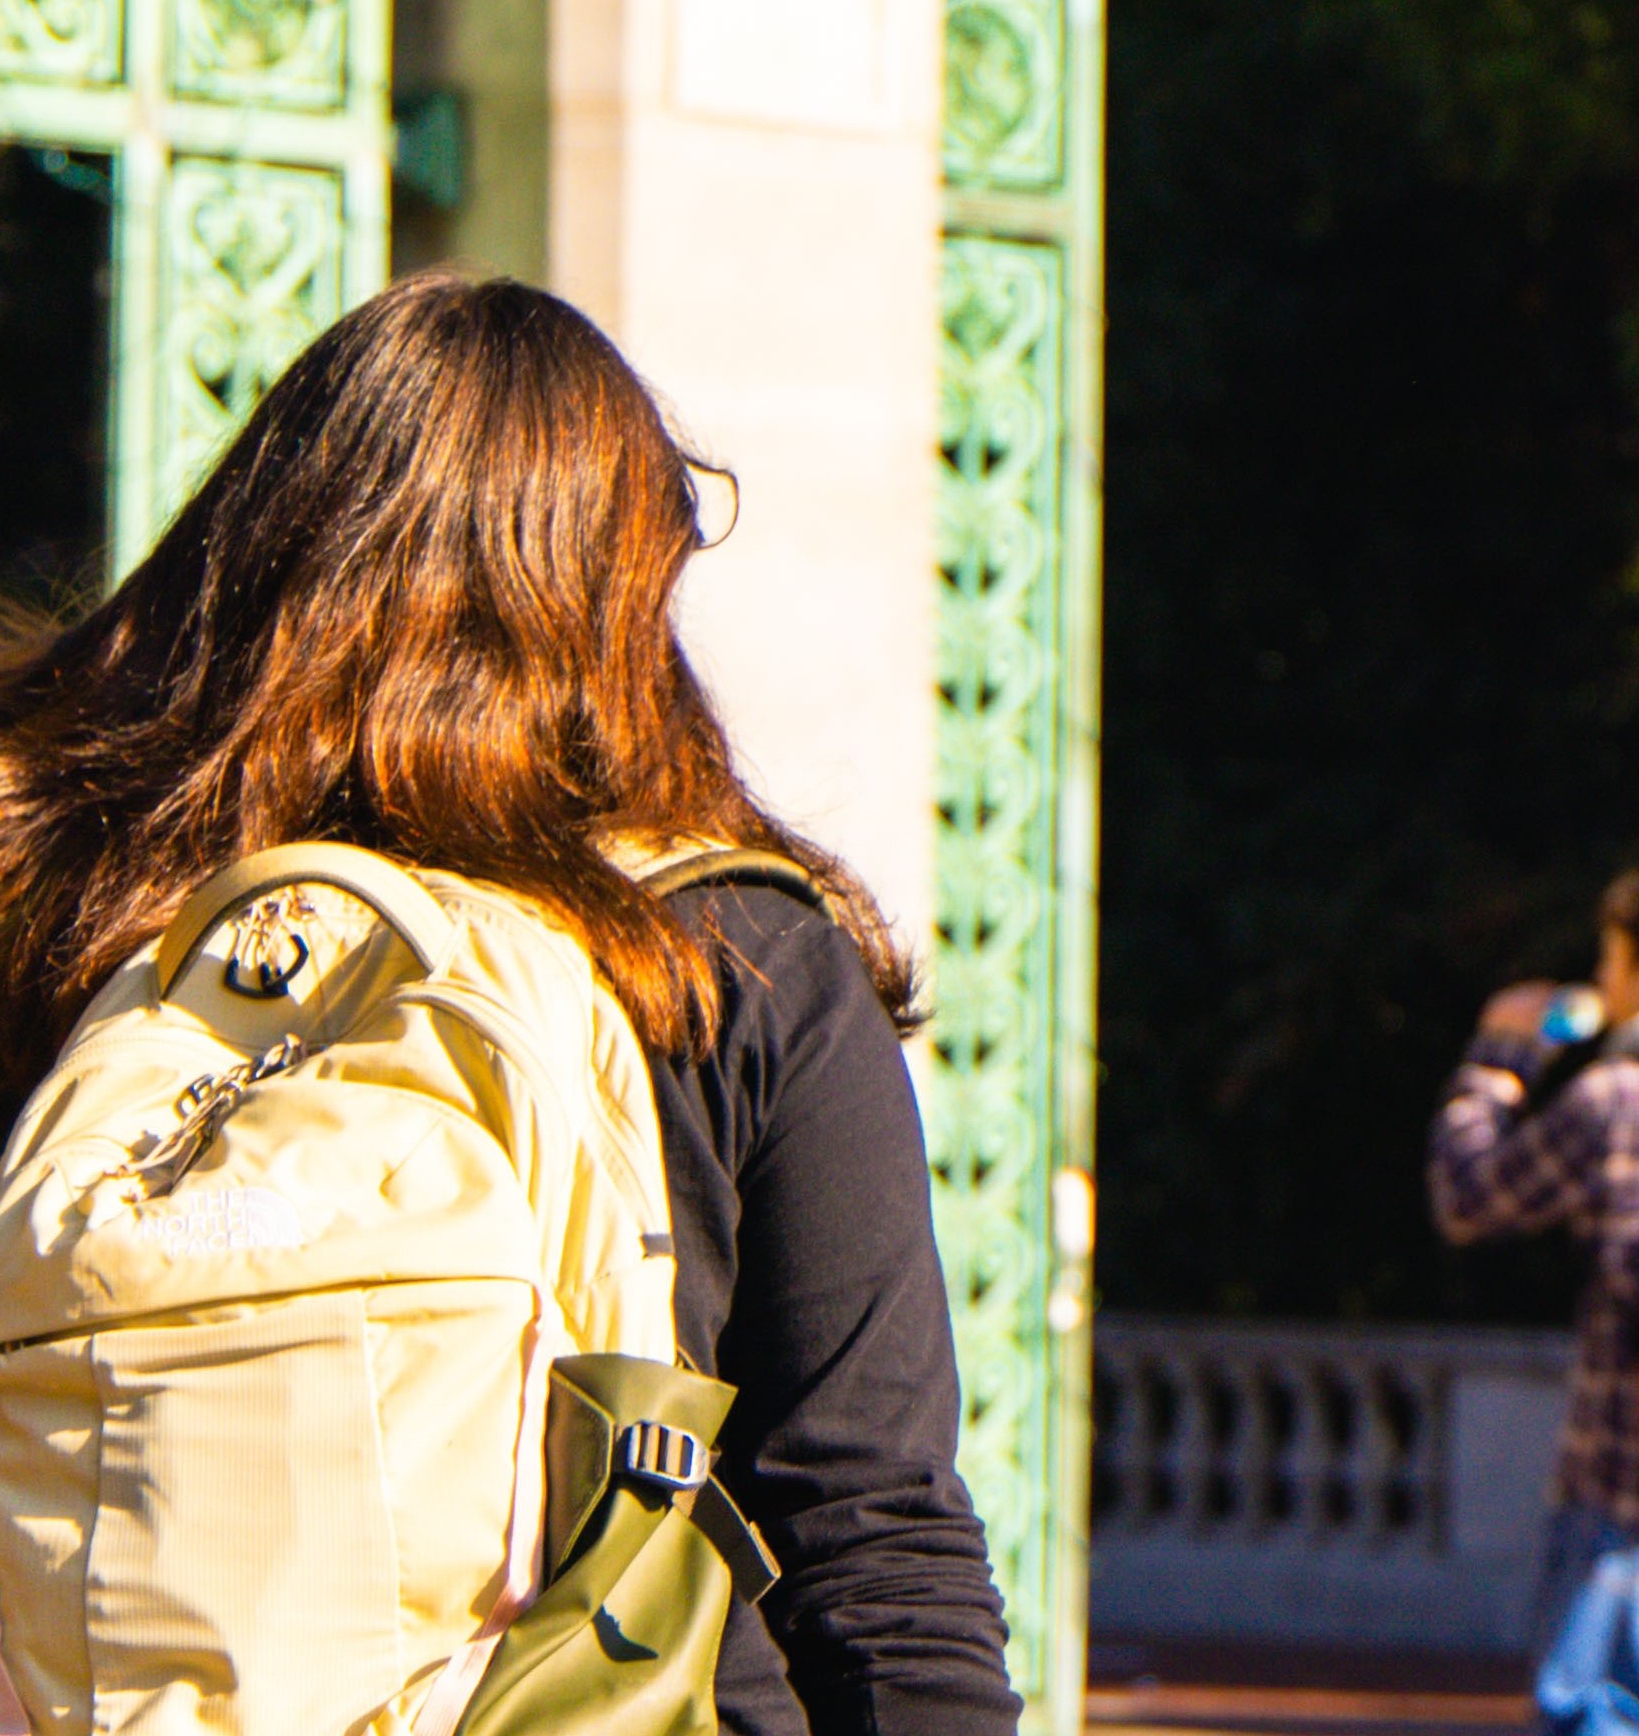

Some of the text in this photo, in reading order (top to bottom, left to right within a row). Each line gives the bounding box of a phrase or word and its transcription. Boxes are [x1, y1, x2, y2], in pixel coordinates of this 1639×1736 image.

[189, 1188, 246, 1214] THE
[140, 1208, 246, 1241] NORTH
[169, 1231, 246, 1257] FACE
